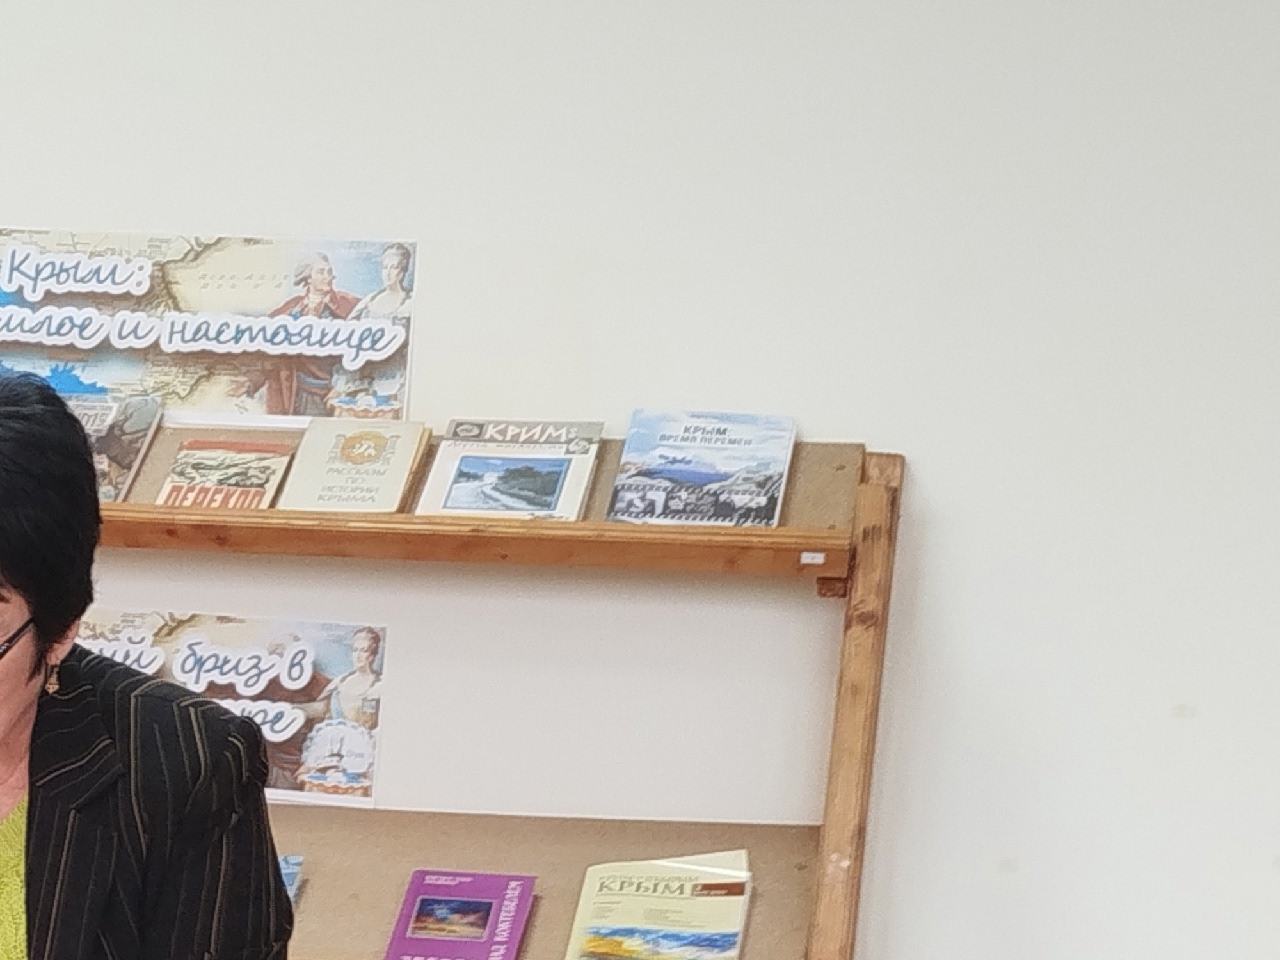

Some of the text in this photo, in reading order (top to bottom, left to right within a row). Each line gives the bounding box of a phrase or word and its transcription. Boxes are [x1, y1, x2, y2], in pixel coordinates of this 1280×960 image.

[7, 249, 145, 294] Крым:
[117, 316, 156, 342] и
[166, 317, 400, 362] настоящее
[180, 642, 276, 688] бриз
[597, 880, 686, 896] КРЫМ
